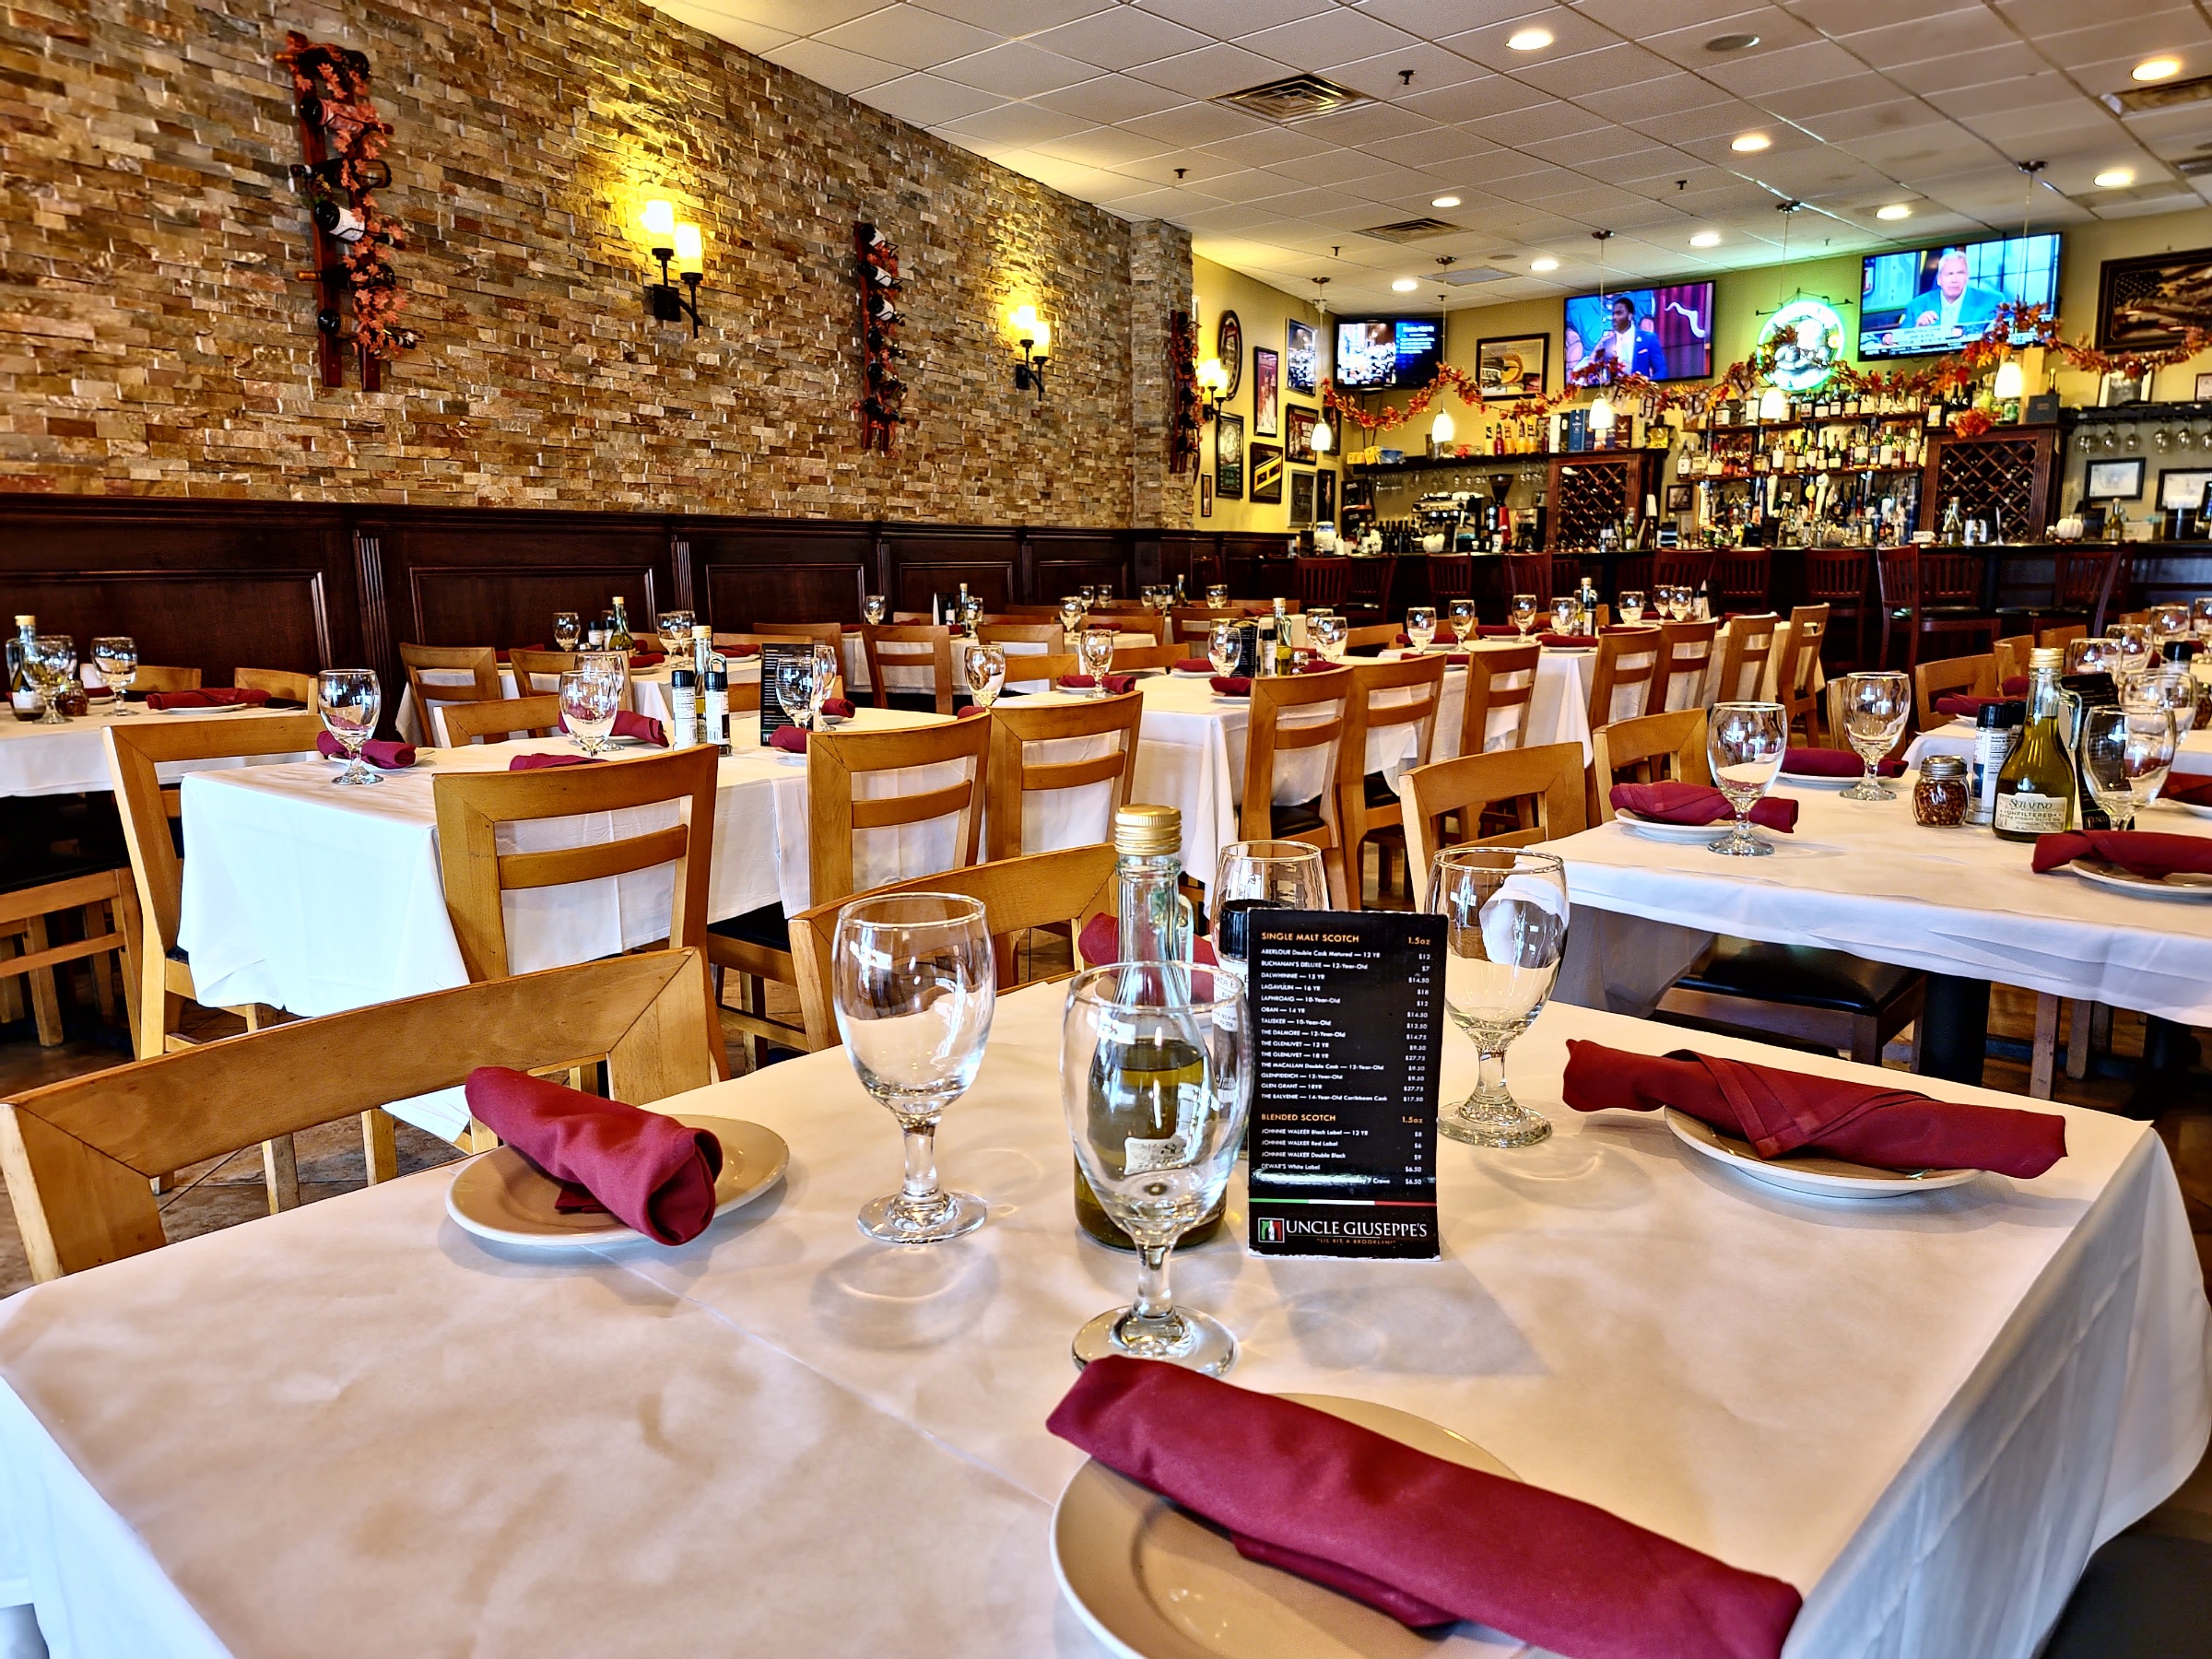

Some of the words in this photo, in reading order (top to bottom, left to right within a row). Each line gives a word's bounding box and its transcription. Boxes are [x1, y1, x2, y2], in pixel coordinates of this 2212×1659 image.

[1261, 932, 1293, 941] SINGLE
[1295, 934, 1319, 942] MALT
[1322, 934, 1359, 943] SCOTCH
[1406, 936, 1430, 945] 1.5oz
[1296, 1018, 1332, 1027] 10-Year-Old
[1261, 1113, 1299, 1122] BLENDED
[1300, 1113, 1336, 1122] SCOTCH
[1402, 1115, 1423, 1124] 1.5oz
[1286, 1220, 1340, 1235] UNCLE
[1343, 1221, 1428, 1237] GIUSEPPE'S
